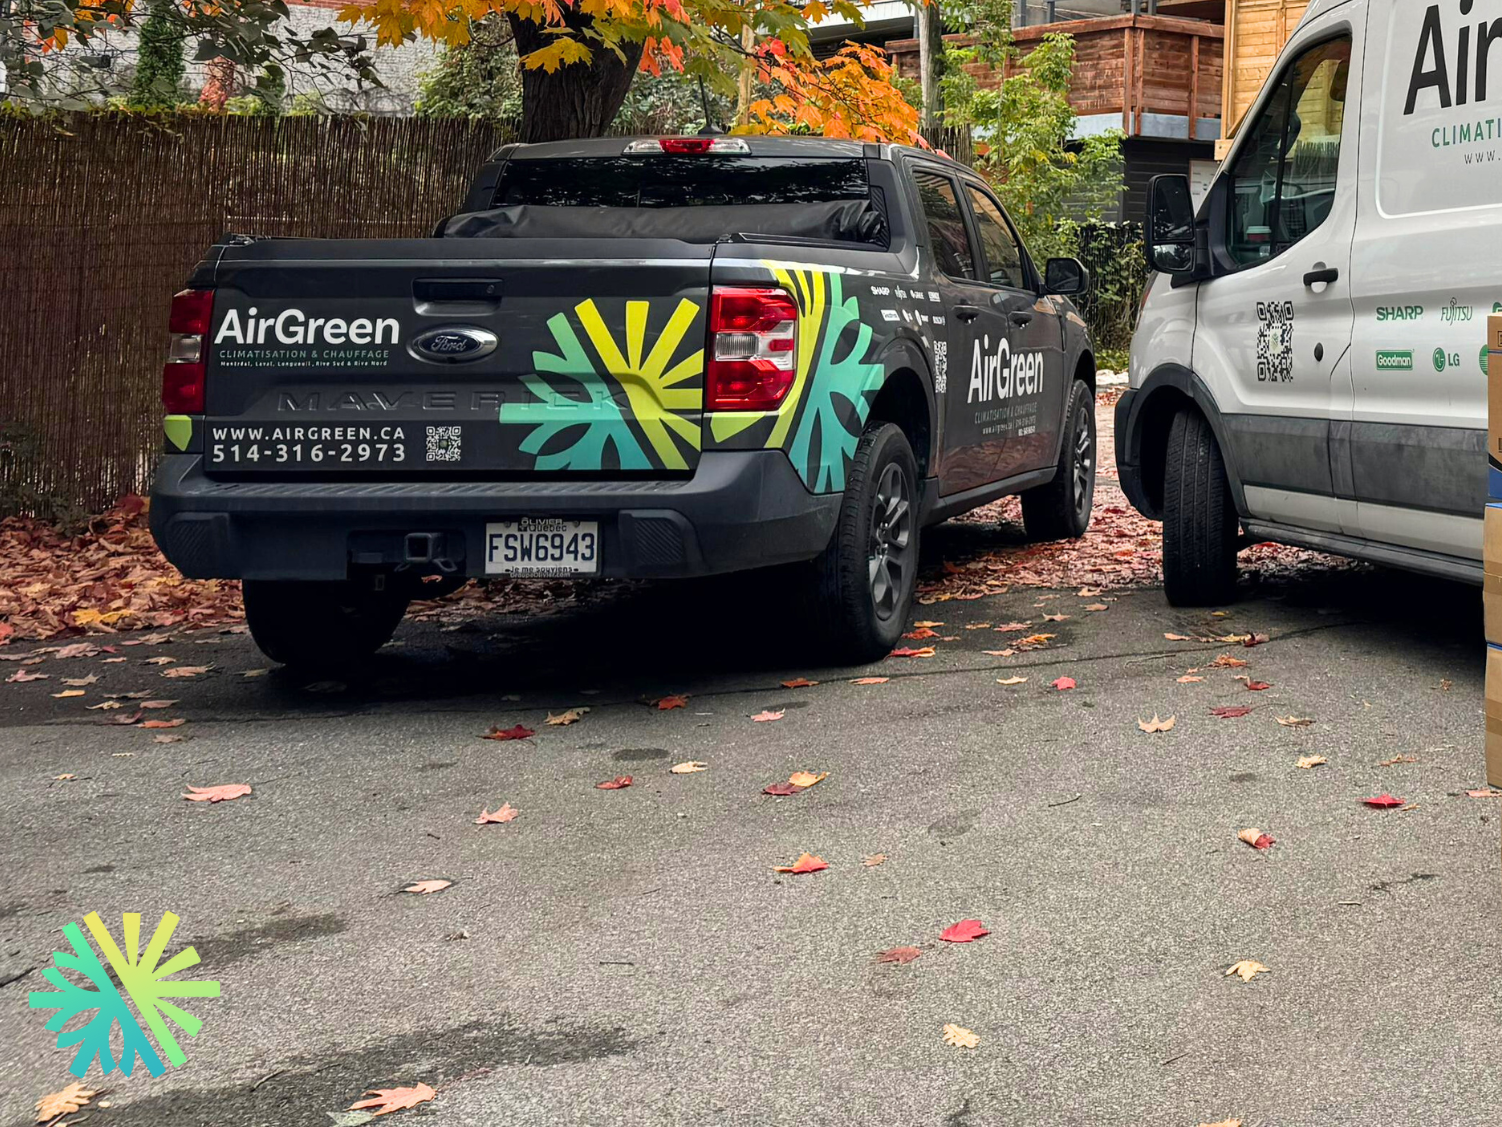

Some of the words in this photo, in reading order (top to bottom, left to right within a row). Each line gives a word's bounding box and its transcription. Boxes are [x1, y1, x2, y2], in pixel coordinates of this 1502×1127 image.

[1376, 305, 1424, 321] SHARP
[1440, 297, 1473, 326] FUJITSU
[214, 307, 400, 344] AirGreen
[431, 335, 467, 351] Ford
[219, 350, 307, 359] CLIMATISATION
[311, 350, 318, 359] &
[323, 350, 389, 359] CHAUFFAGE
[1377, 353, 1411, 366] Goodman
[1448, 353, 1460, 367] LG
[967, 334, 1044, 404] AirGreen
[212, 427, 405, 440] WWW.AIRGREEN.CA
[212, 443, 405, 462] 514-316-2973
[488, 533, 595, 562] FSW6943
